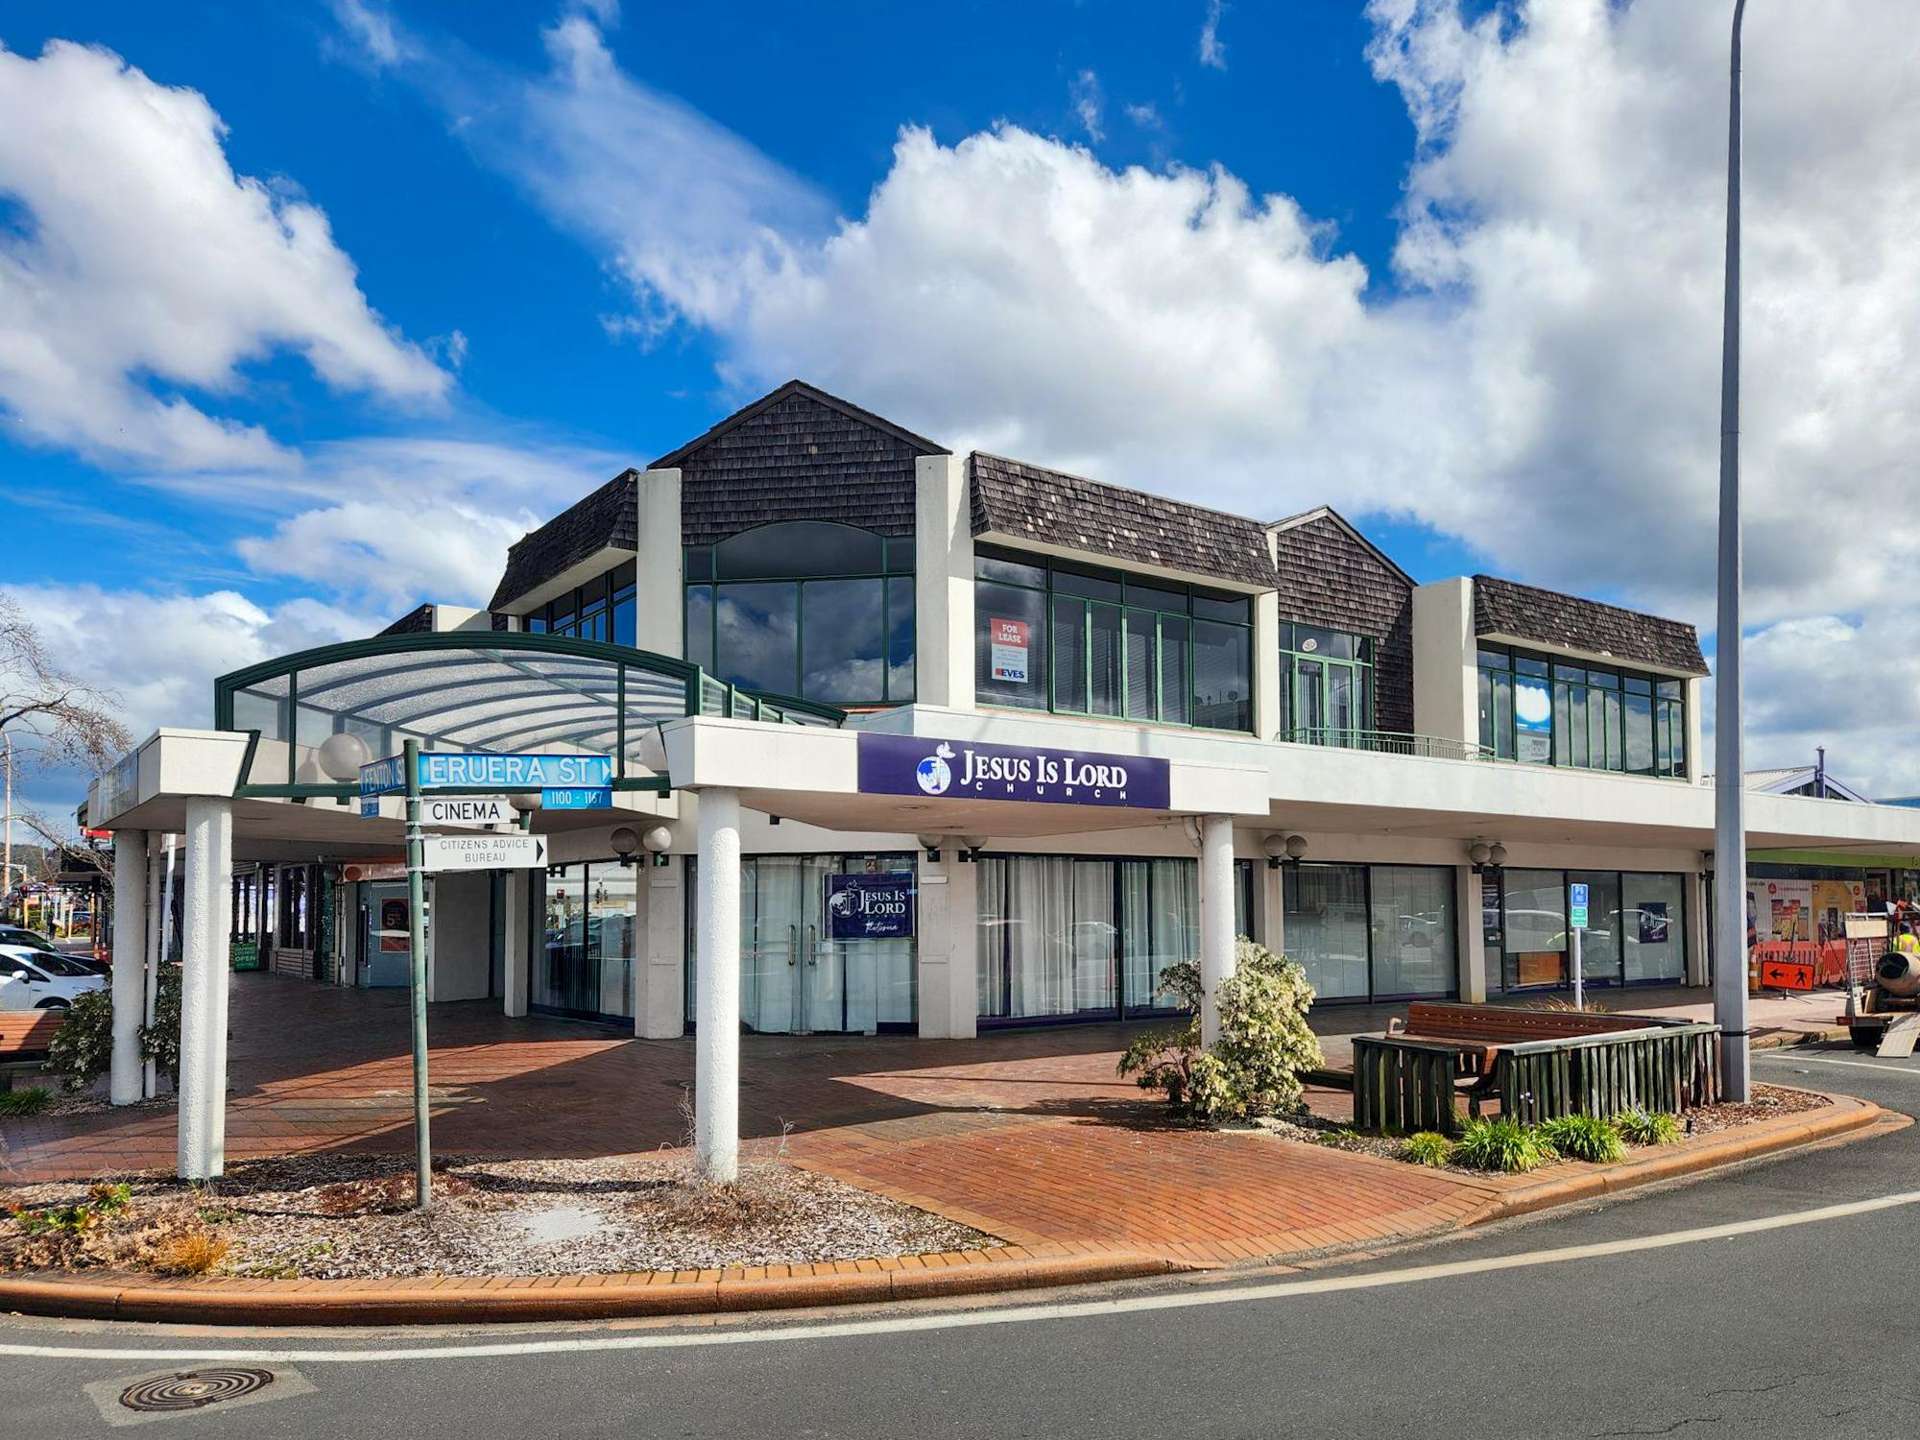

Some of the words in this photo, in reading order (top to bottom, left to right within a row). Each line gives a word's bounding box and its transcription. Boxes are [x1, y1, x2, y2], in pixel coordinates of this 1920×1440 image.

[1002, 624, 1018, 634] FOR
[998, 632, 1022, 643] LEASE
[1001, 668, 1025, 679] EVES
[429, 756, 547, 783] ERUERA
[559, 757, 591, 783] ST
[960, 750, 1031, 786] JESUS
[1036, 755, 1058, 784] IS
[1063, 758, 1128, 788] LORD
[976, 781, 1127, 800] CHURCH
[551, 791, 572, 805] 1100
[432, 802, 501, 821] CINEMA
[440, 840, 488, 850] CITIZENS
[492, 839, 529, 849] ADVICE
[464, 853, 506, 863] BUREAU
[858, 889, 893, 911] JESUS
[895, 890, 906, 901] IS
[864, 901, 906, 914] LORD
